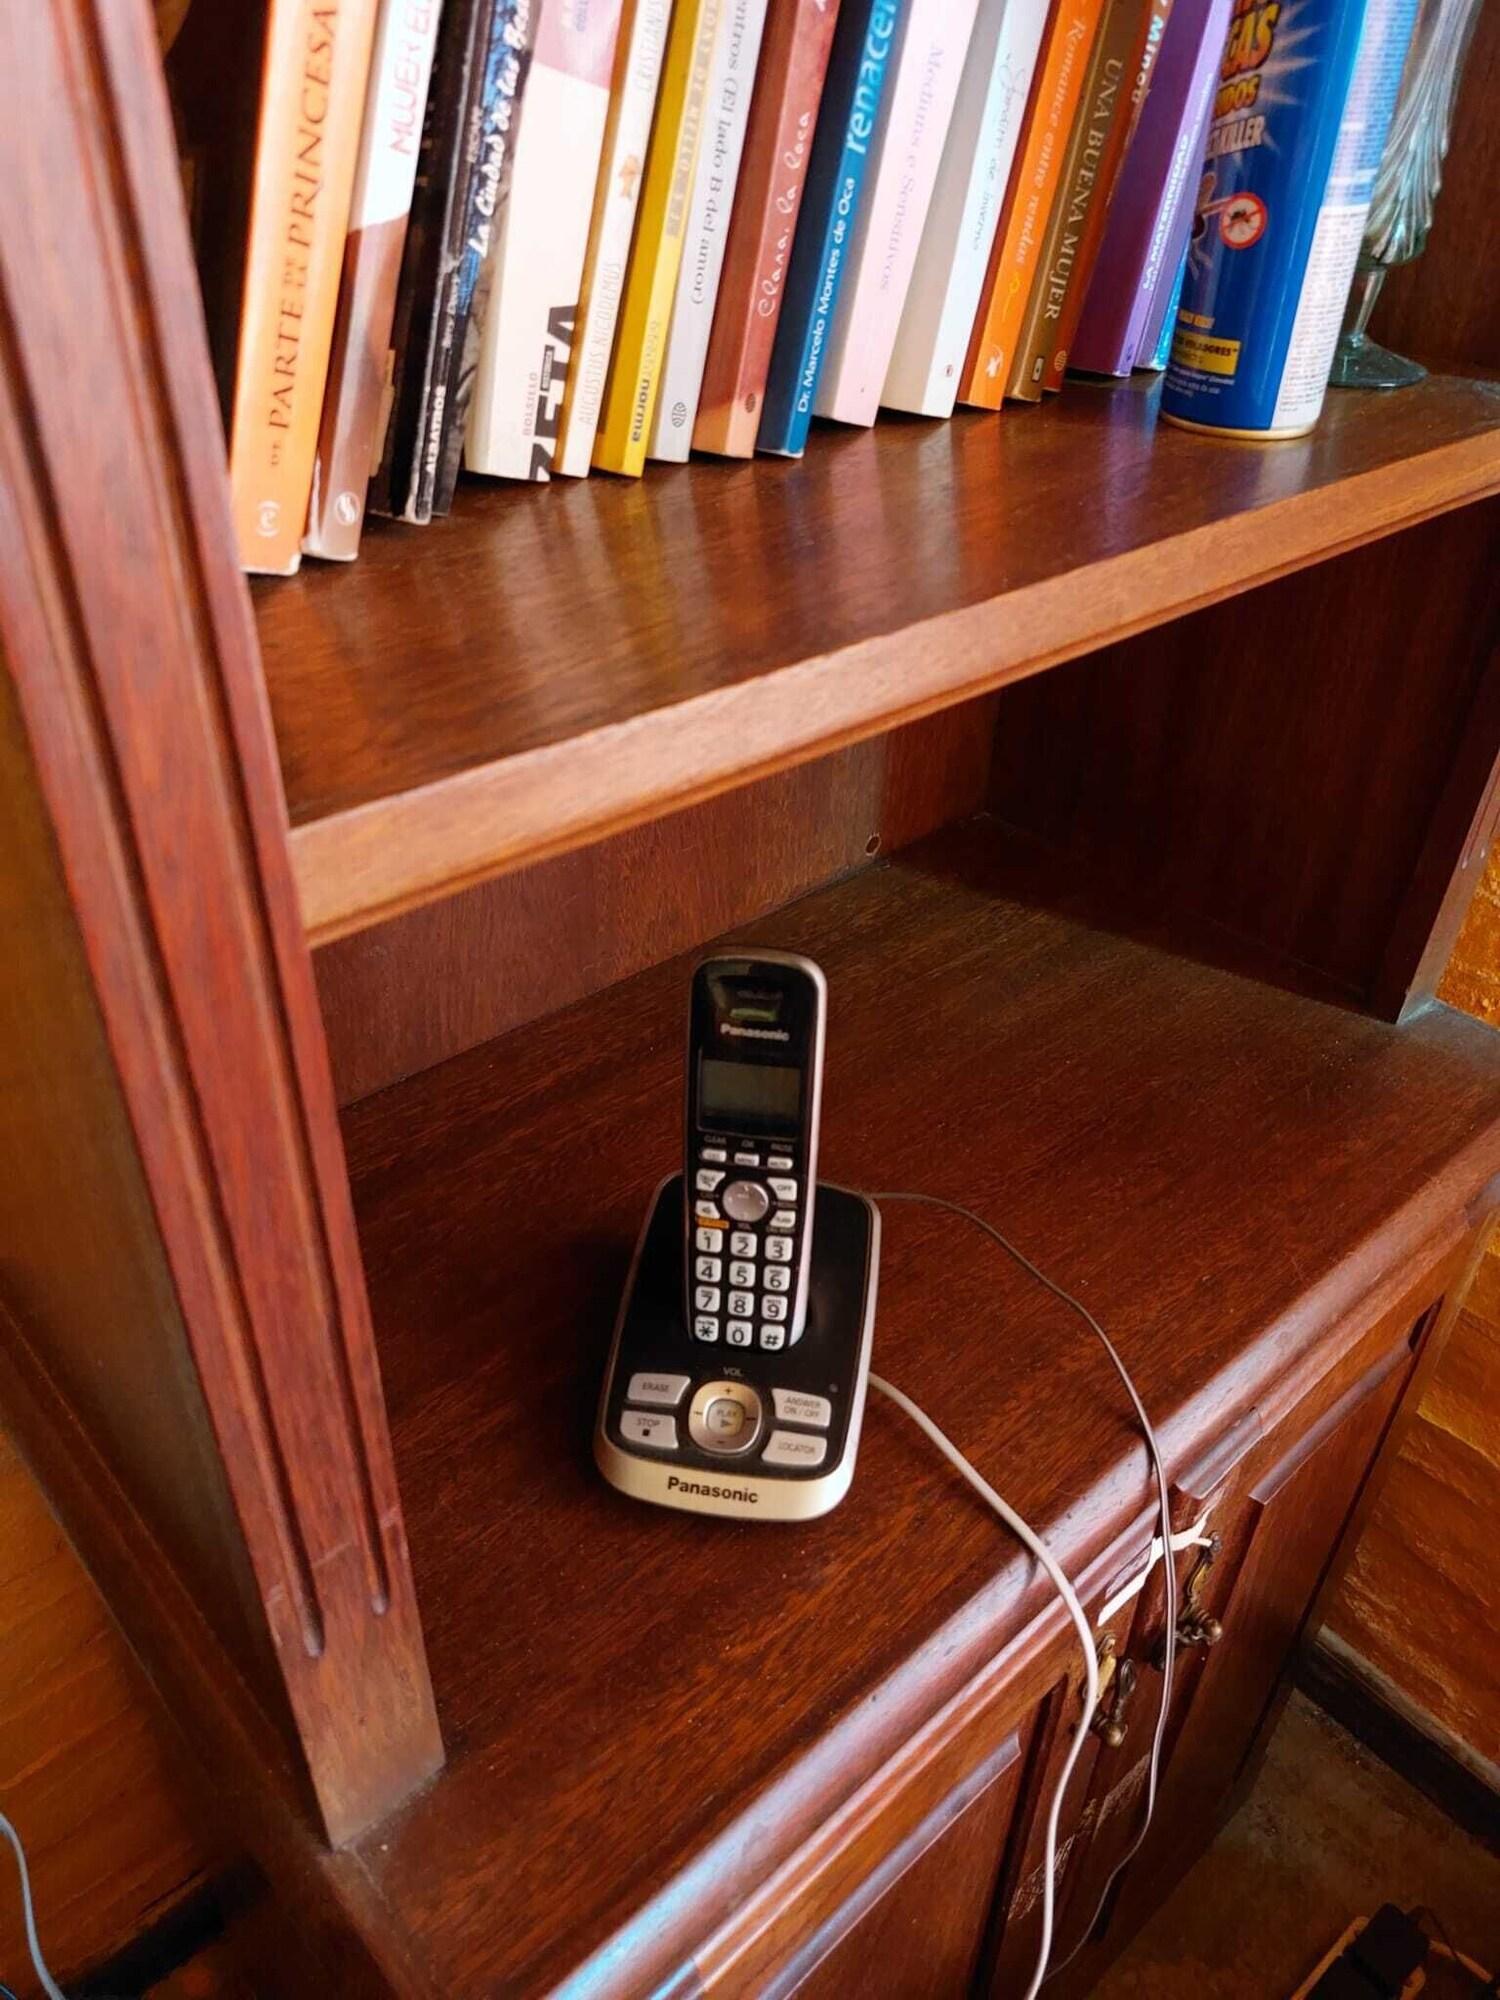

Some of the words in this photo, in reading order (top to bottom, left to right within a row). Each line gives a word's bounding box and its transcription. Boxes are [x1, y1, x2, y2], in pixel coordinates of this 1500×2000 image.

[496, 57, 522, 98] las
[1046, 16, 1087, 127] Romance
[389, 38, 421, 157] MUJER
[720, 76, 738, 113] (El
[1092, 57, 1123, 121] UNA
[285, 6, 337, 257] PRINCESA
[495, 99, 513, 133] de
[711, 119, 733, 168] lado
[781, 107, 810, 171] loca
[475, 133, 506, 219] Ciudad
[1032, 131, 1056, 188] entre
[1066, 128, 1105, 224] BUENA
[708, 176, 724, 194] B
[774, 181, 797, 215] la
[836, 176, 856, 216] Oca
[1148, 134, 1189, 264] MATERNIDAD
[701, 198, 720, 234] del
[831, 217, 847, 245] de
[468, 226, 487, 259] La
[689, 238, 713, 306] amor)
[816, 246, 841, 315] Montes
[1042, 230, 1079, 321] MUJER
[267, 306, 303, 432] PARTE
[801, 317, 827, 388] Marcelo
[523, 370, 538, 437] BOLSILLO
[529, 304, 578, 482] ZETA
[797, 389, 811, 413] Dr.
[425, 383, 447, 473] ALBATROS
[630, 378, 651, 444] norma
[720, 1023, 790, 1041] Panasonic
[776, 1184, 793, 1192] OFF
[704, 1236, 711, 1250] 1
[737, 1239, 749, 1255] 2
[773, 1243, 784, 1259] 3
[701, 1264, 713, 1279] 4
[736, 1269, 748, 1285] 5
[769, 1272, 782, 1289] 6
[702, 1293, 713, 1309] 7
[734, 1299, 746, 1314] 8
[767, 1303, 780, 1318] 9
[732, 1329, 744, 1344] 0
[764, 1333, 779, 1347] #
[642, 1382, 670, 1393] ERASE
[723, 1366, 743, 1377] VOL
[636, 1417, 661, 1428] STOP
[783, 1404, 799, 1416] ON
[806, 1406, 821, 1418] OFF
[667, 1475, 759, 1504] Panasonic
